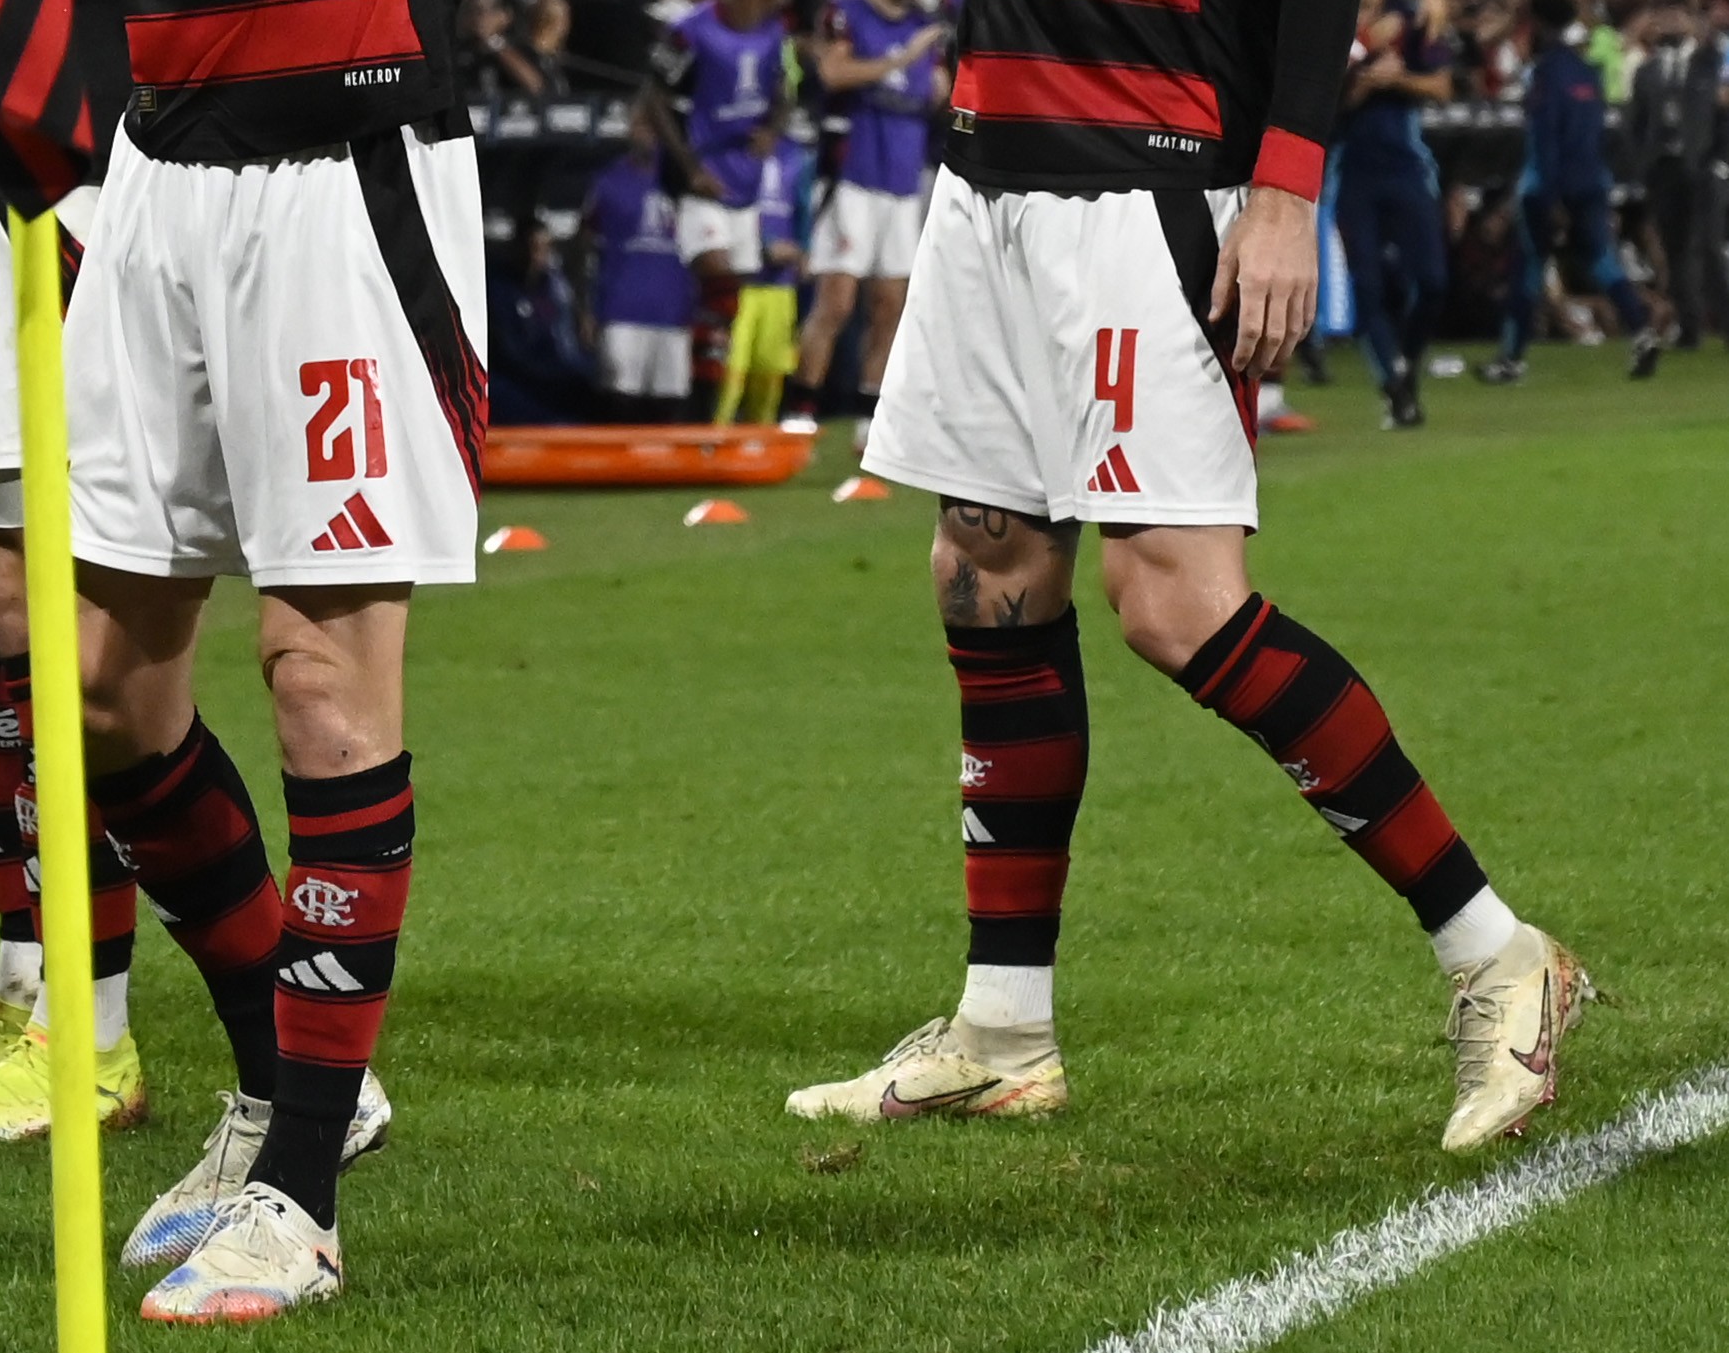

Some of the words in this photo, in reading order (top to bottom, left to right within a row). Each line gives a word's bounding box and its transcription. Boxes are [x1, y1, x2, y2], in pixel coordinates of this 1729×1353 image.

[344, 66, 401, 87] HEAT.RDY
[1147, 134, 1202, 154] HEAT.RDY
[1094, 327, 1139, 433] 4
[299, 357, 388, 484] 21
